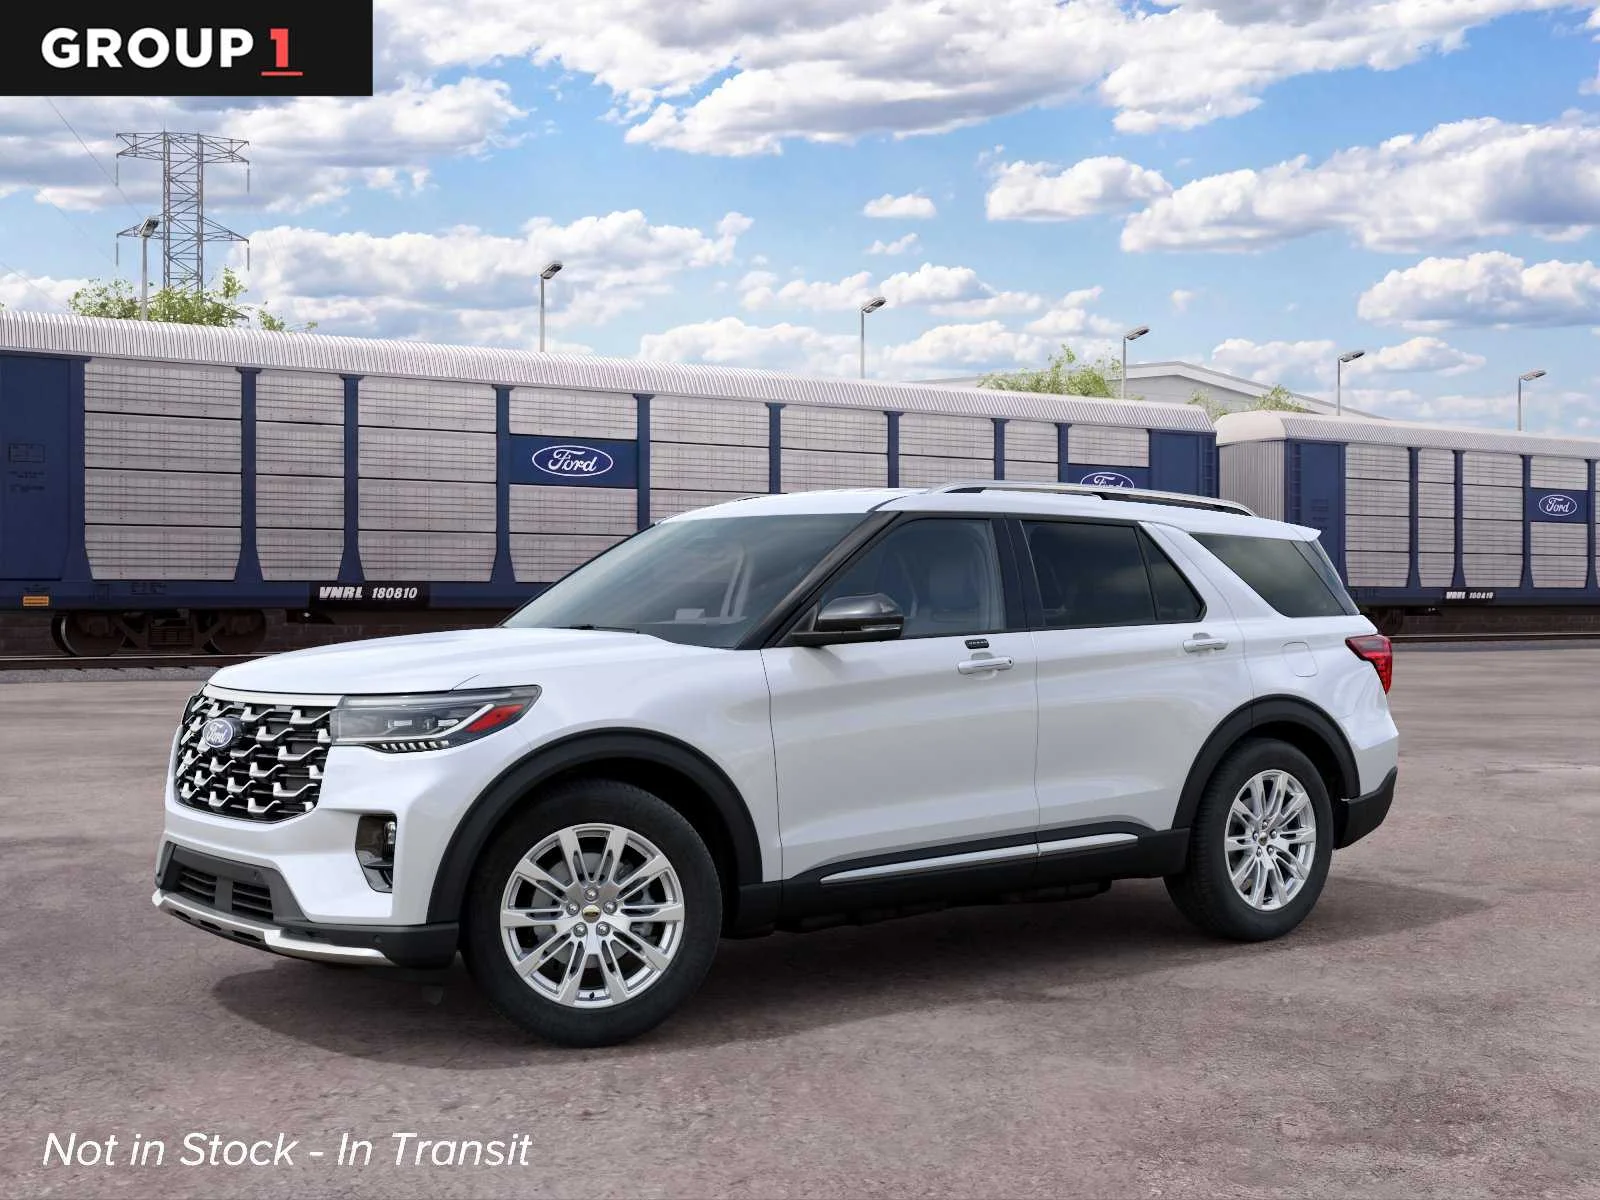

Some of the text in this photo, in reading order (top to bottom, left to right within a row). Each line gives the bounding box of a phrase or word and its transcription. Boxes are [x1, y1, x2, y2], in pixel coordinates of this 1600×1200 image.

[547, 448, 598, 472] Ford
[1546, 497, 1570, 513] Ford
[371, 587, 418, 599] 180810
